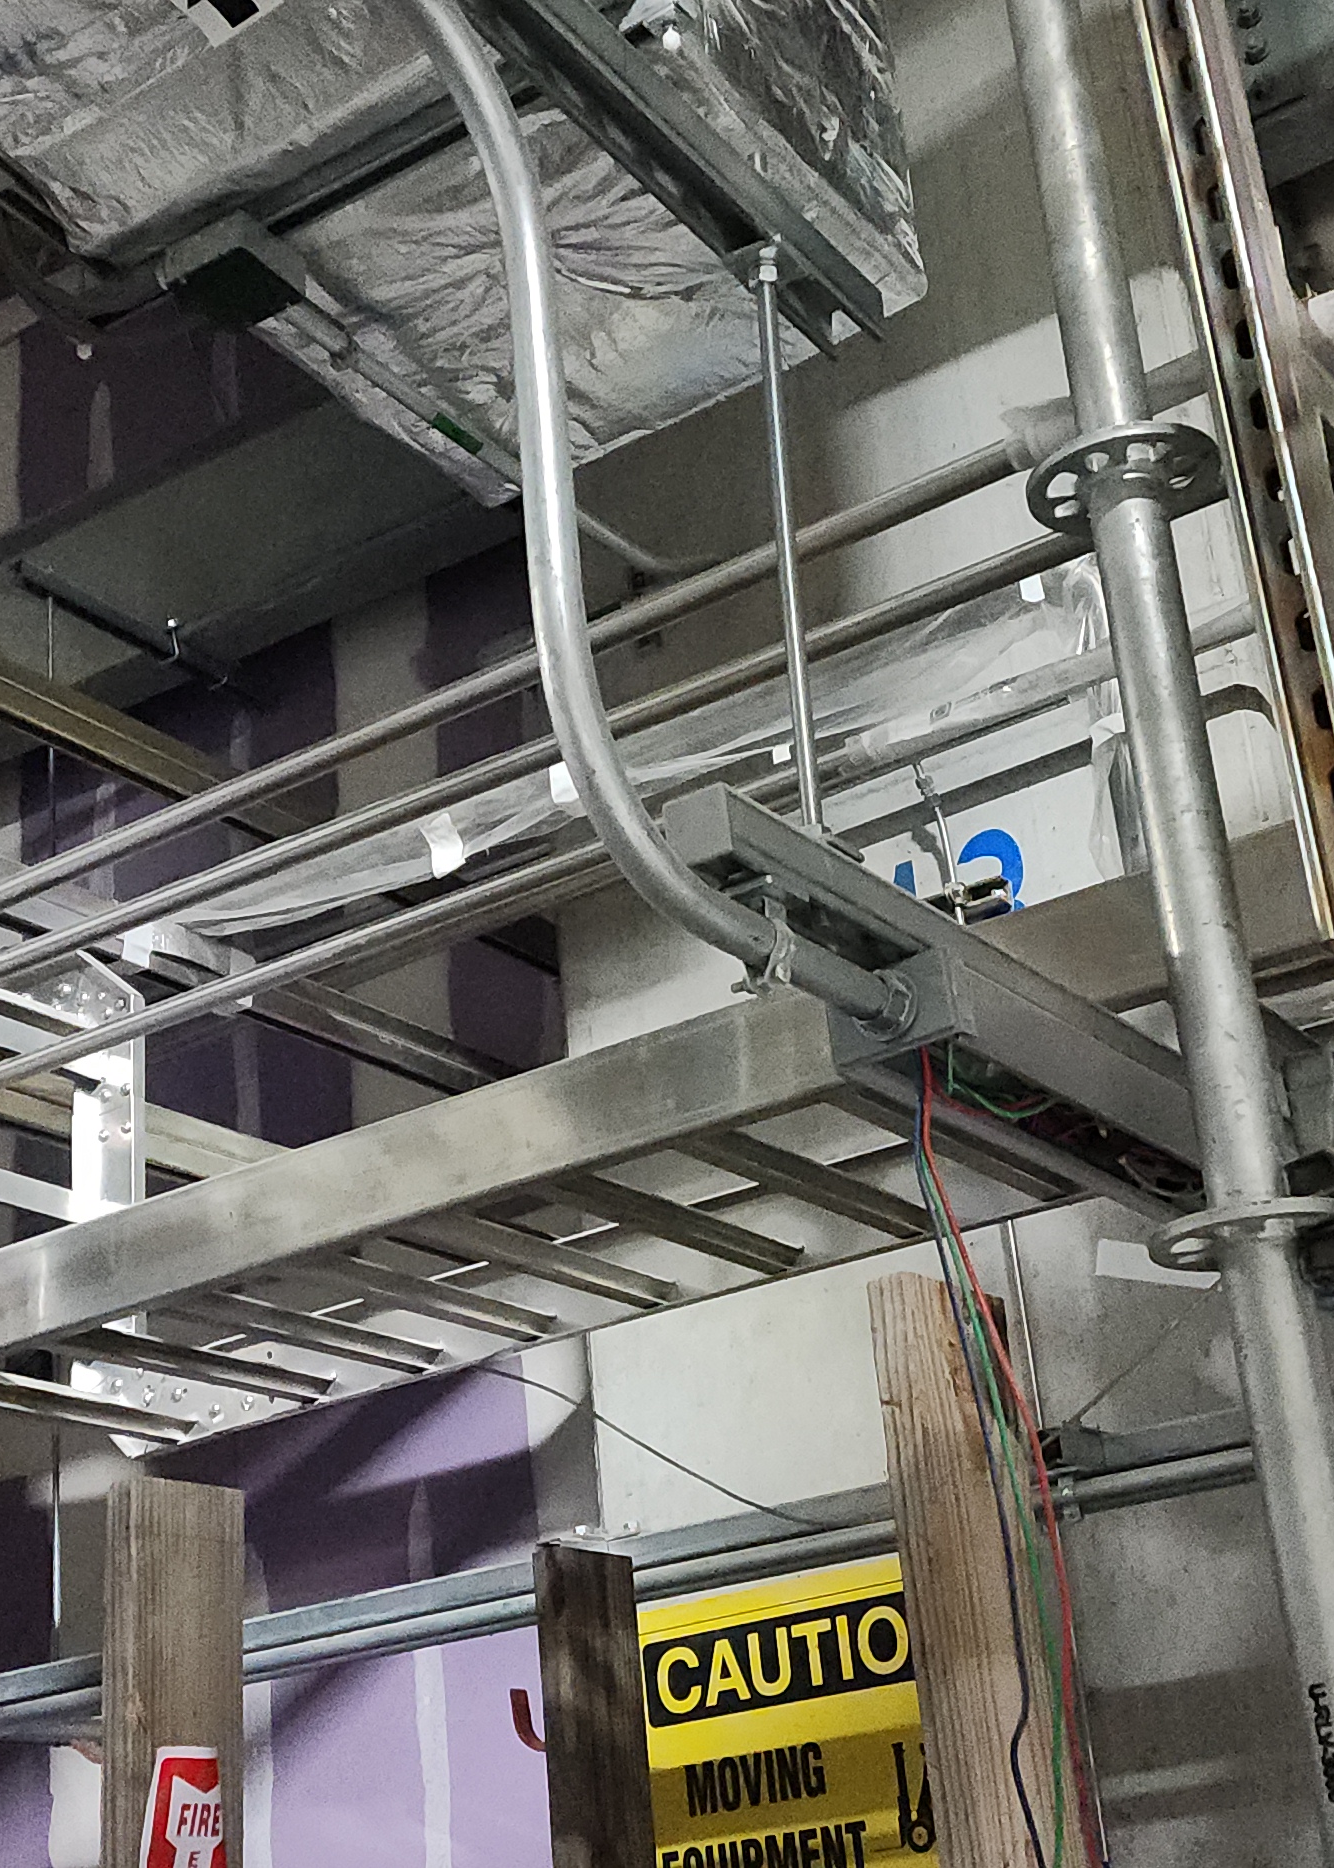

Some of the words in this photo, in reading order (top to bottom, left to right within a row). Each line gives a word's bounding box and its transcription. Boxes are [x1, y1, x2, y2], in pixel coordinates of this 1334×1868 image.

[656, 1604, 910, 1715] CAUTIO
[684, 1741, 827, 1818] MOVING
[176, 1802, 221, 1838] FIRE
